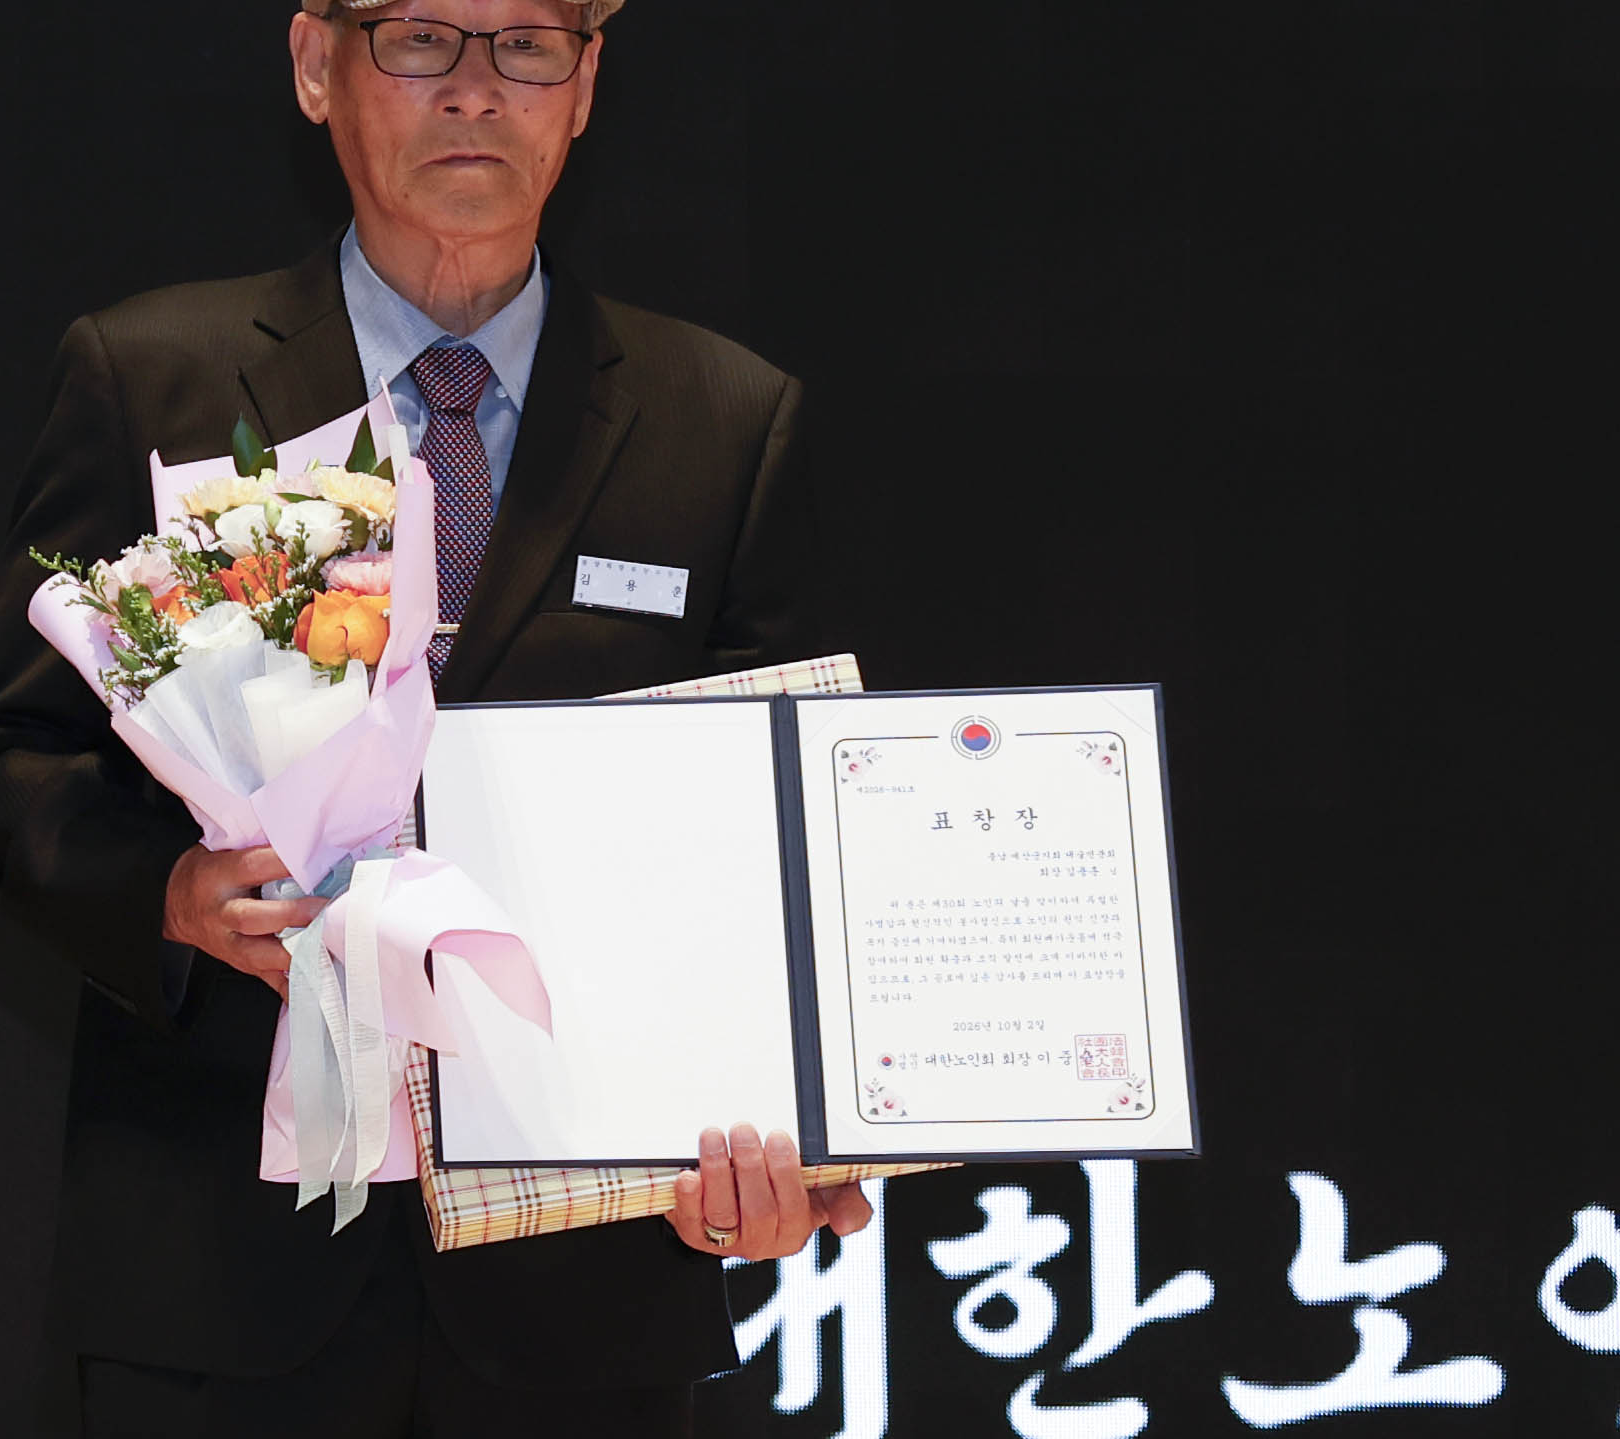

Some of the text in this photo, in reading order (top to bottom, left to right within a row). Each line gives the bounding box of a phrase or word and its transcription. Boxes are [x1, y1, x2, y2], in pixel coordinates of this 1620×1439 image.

[952, 1019, 1045, 1032] 2026년 10월 2일
[925, 1050, 995, 1069] 대한노인회
[1001, 1050, 1031, 1067] 회장
